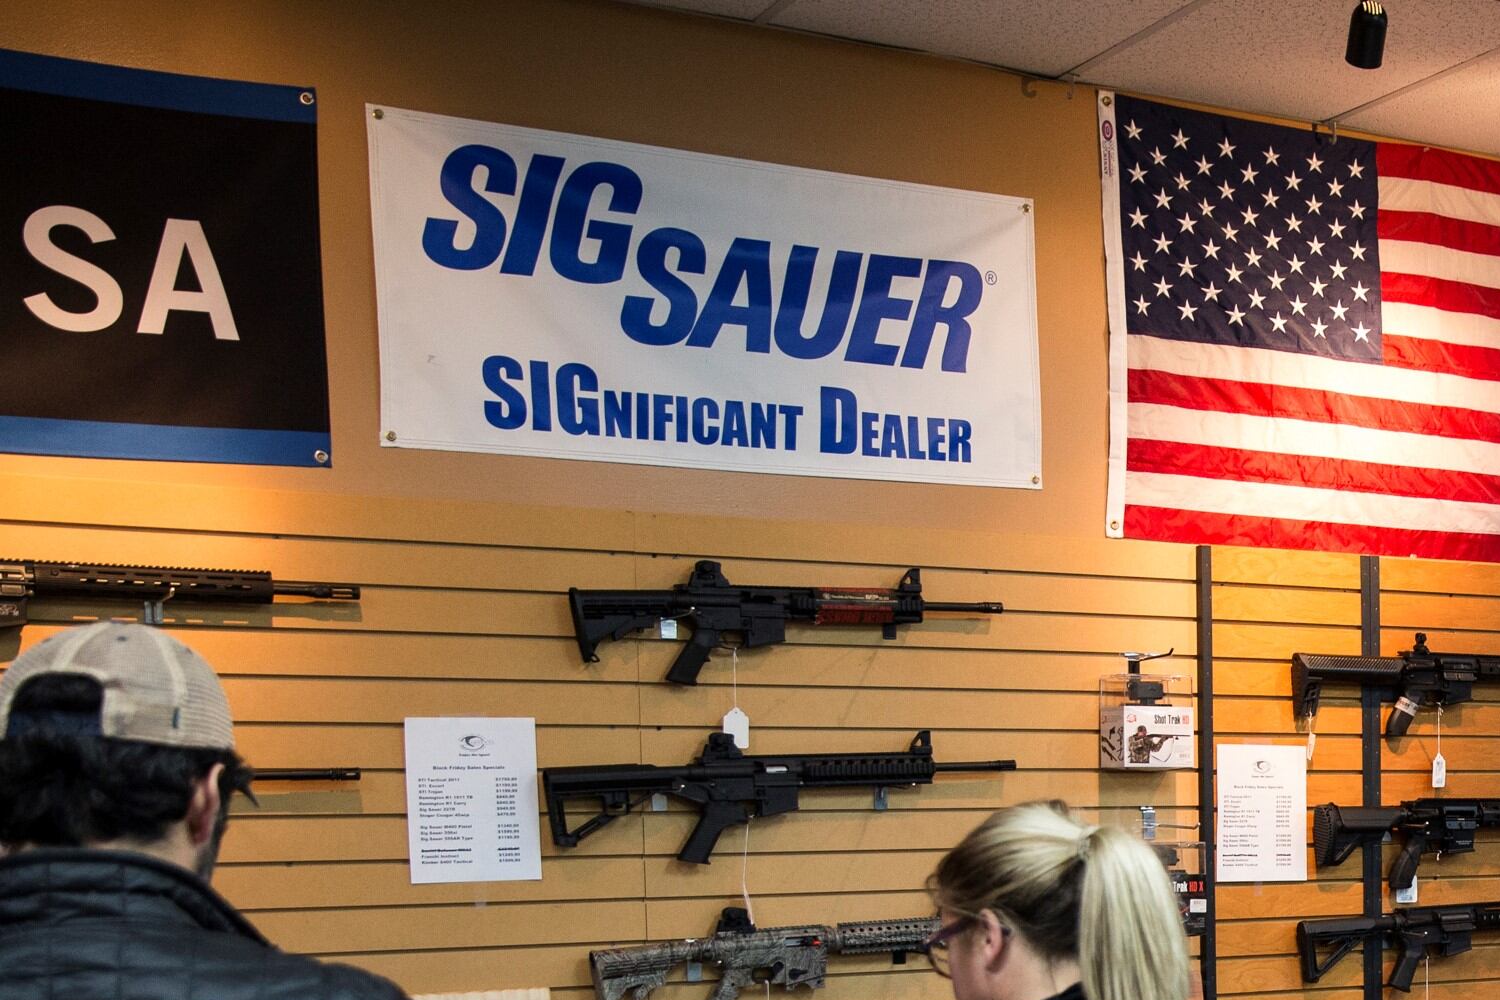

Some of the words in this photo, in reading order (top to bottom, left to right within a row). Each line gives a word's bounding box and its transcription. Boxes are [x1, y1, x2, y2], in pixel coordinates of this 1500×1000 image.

[422, 144, 643, 285] SIG
[620, 227, 984, 374] SAUER
[481, 355, 803, 452] SIGNIFICANT
[1154, 714, 1167, 725] Shot
[1168, 714, 1181, 725] Trak
[1173, 881, 1188, 893] Trak
